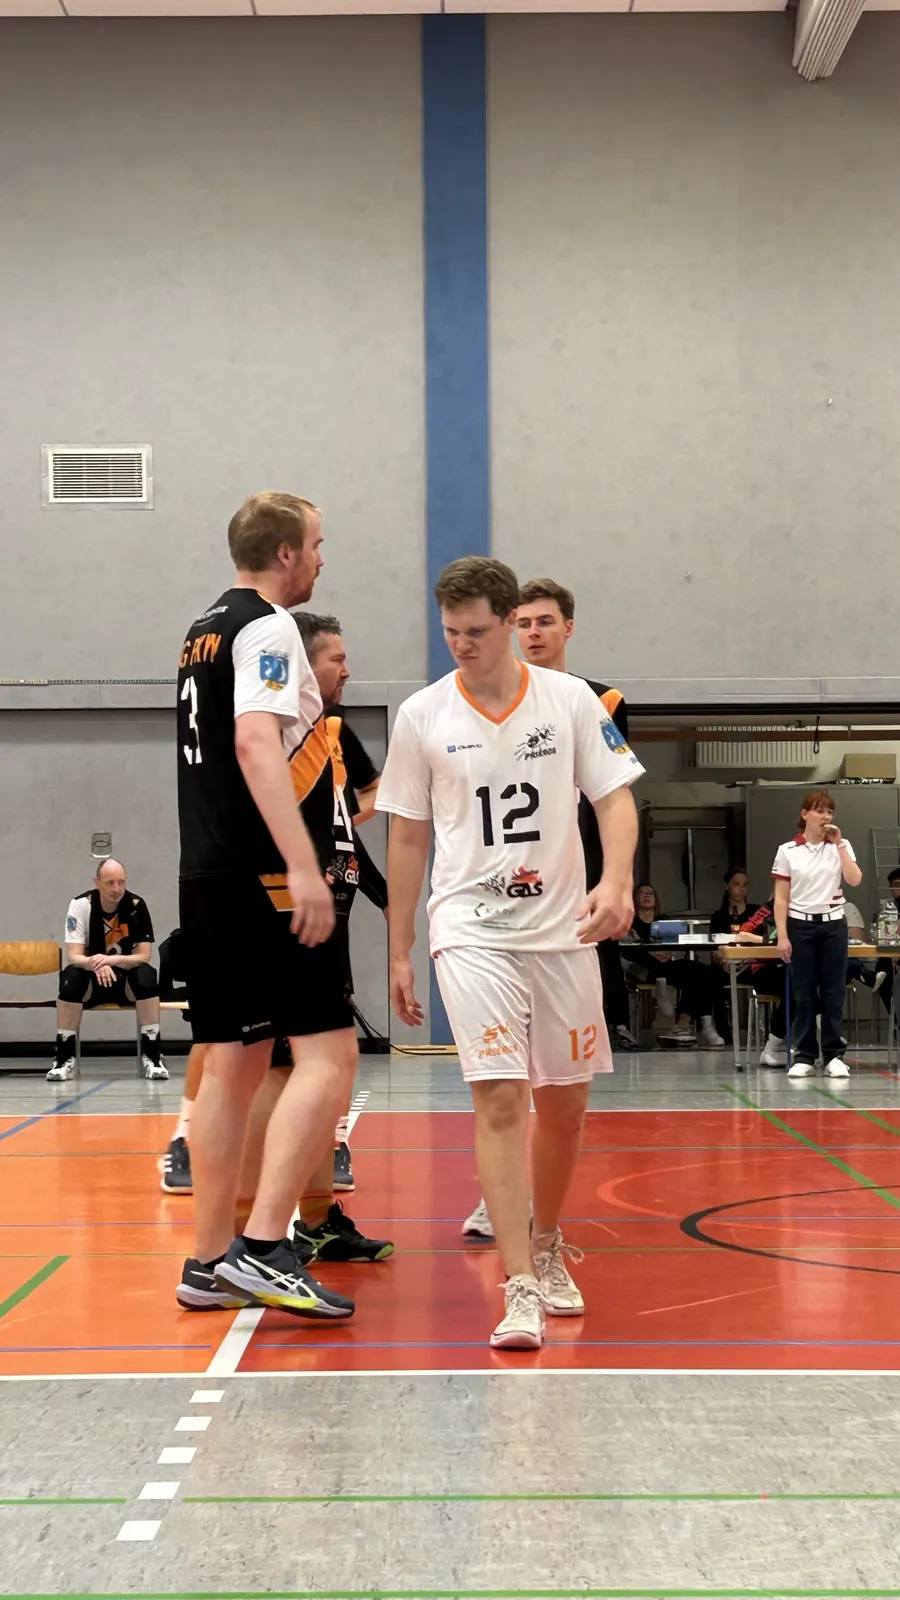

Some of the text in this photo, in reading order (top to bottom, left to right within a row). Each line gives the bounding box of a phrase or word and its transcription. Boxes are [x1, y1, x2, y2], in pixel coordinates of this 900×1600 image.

[180, 676, 202, 766] 3
[475, 782, 541, 847] 12
[567, 1023, 597, 1062] 12
